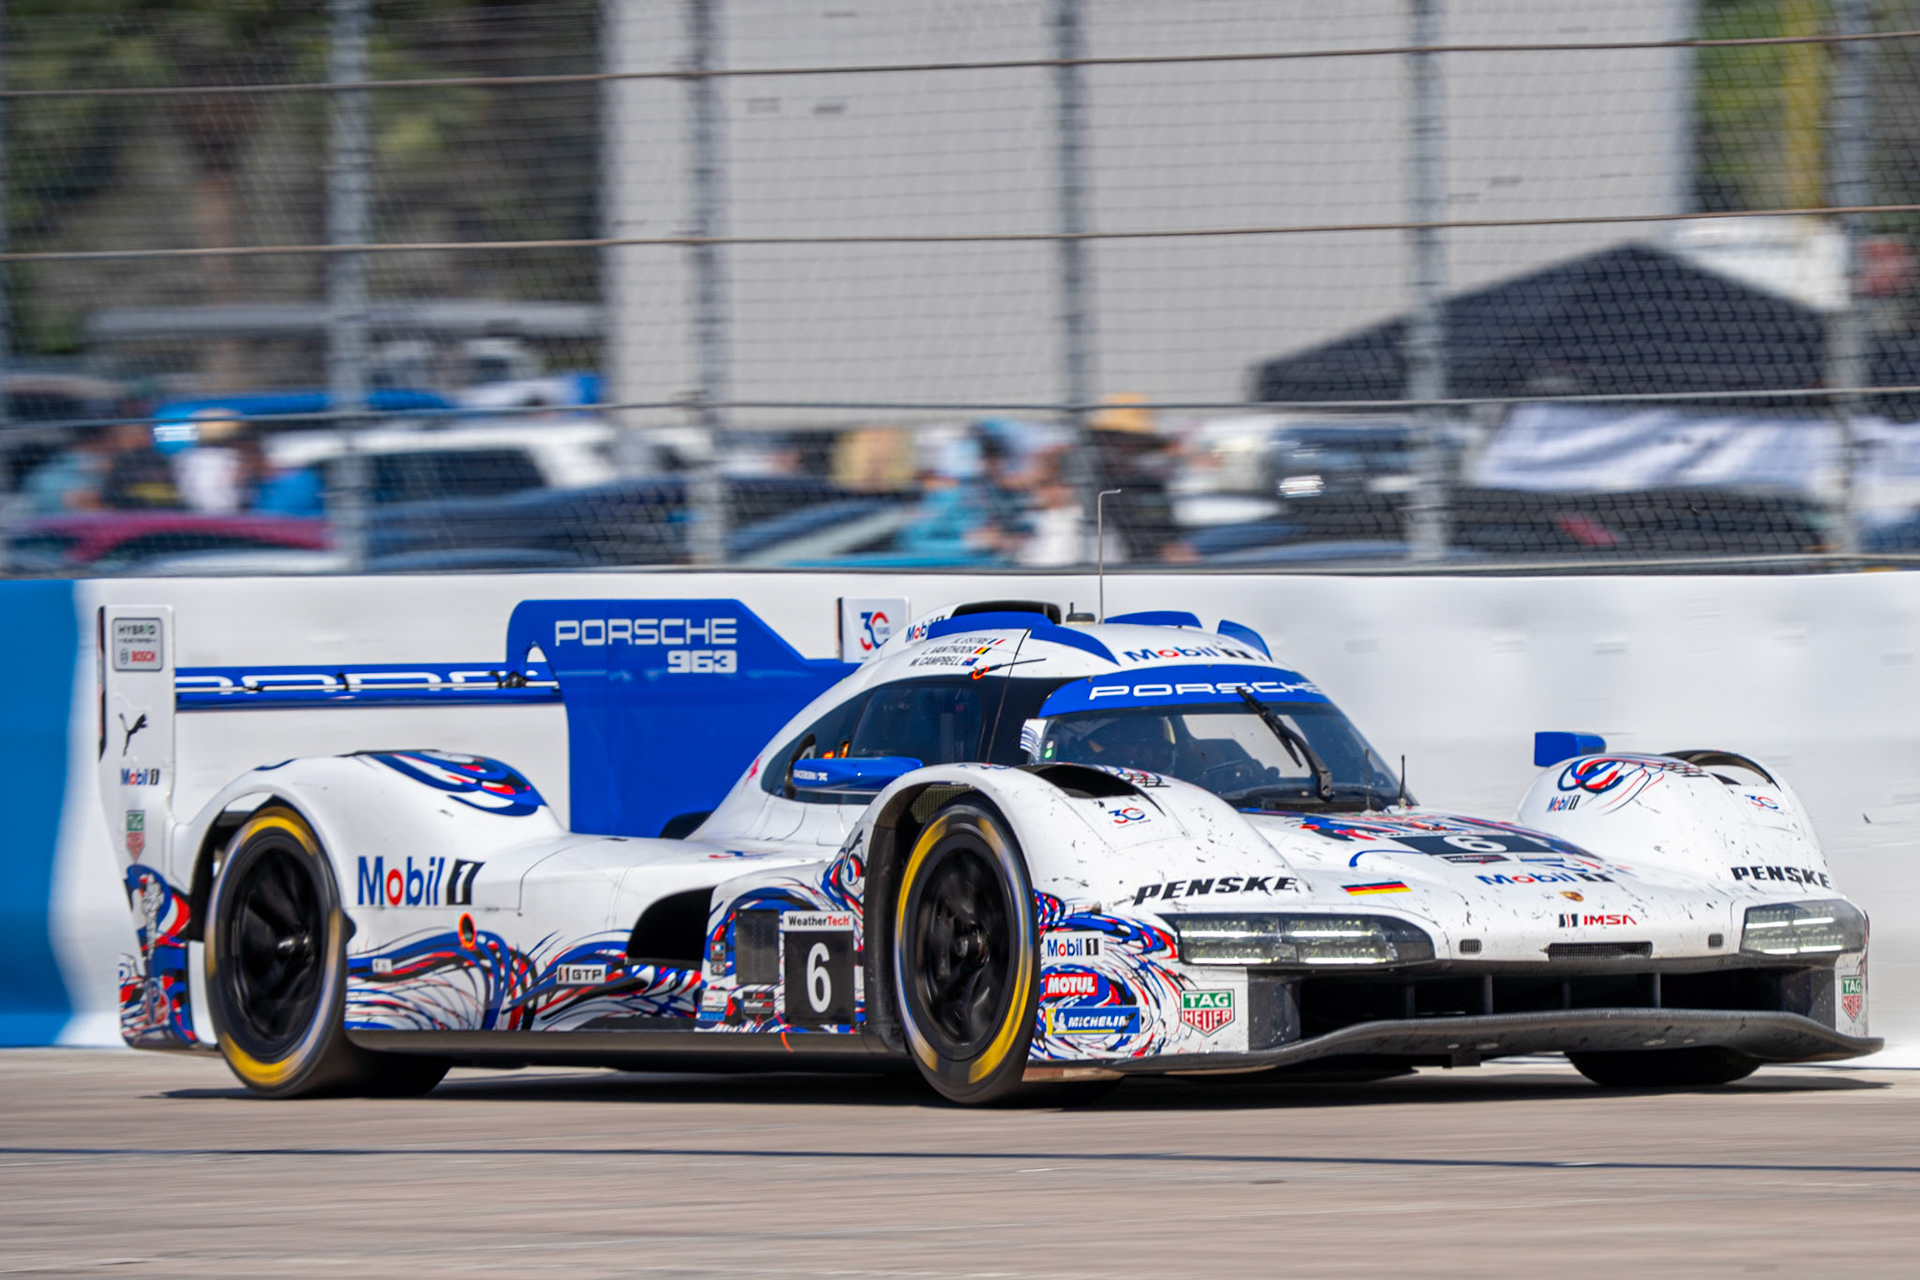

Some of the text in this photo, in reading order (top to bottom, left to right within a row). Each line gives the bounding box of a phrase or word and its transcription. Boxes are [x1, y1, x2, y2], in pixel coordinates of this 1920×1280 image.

[555, 618, 737, 647] PORSCHE
[131, 651, 156, 662] BOSCH
[667, 650, 737, 673] 963
[919, 656, 963, 667] CAMPBELL
[1123, 646, 1220, 663] Mobil
[1089, 682, 1322, 700] PORSCHE
[121, 768, 160, 786] Mobil 1
[1546, 796, 1571, 812] Mobil
[1444, 836, 1507, 852] 6
[357, 856, 482, 906] Mobil 1
[1475, 873, 1577, 885] Mobil
[1731, 866, 1830, 889] PENSKE
[1133, 876, 1299, 906] PENSKE
[788, 915, 850, 926] WeatherTech
[1583, 914, 1637, 926] IMSA
[1047, 938, 1099, 957] Mobil 1
[572, 970, 602, 981] GTP
[806, 942, 831, 1013] 6
[1046, 976, 1096, 995] MOTUL
[1843, 979, 1861, 993] TAG
[1186, 993, 1229, 1006] TAG
[1068, 1015, 1131, 1028] MICHELIN
[1183, 1009, 1232, 1032] HEUER
